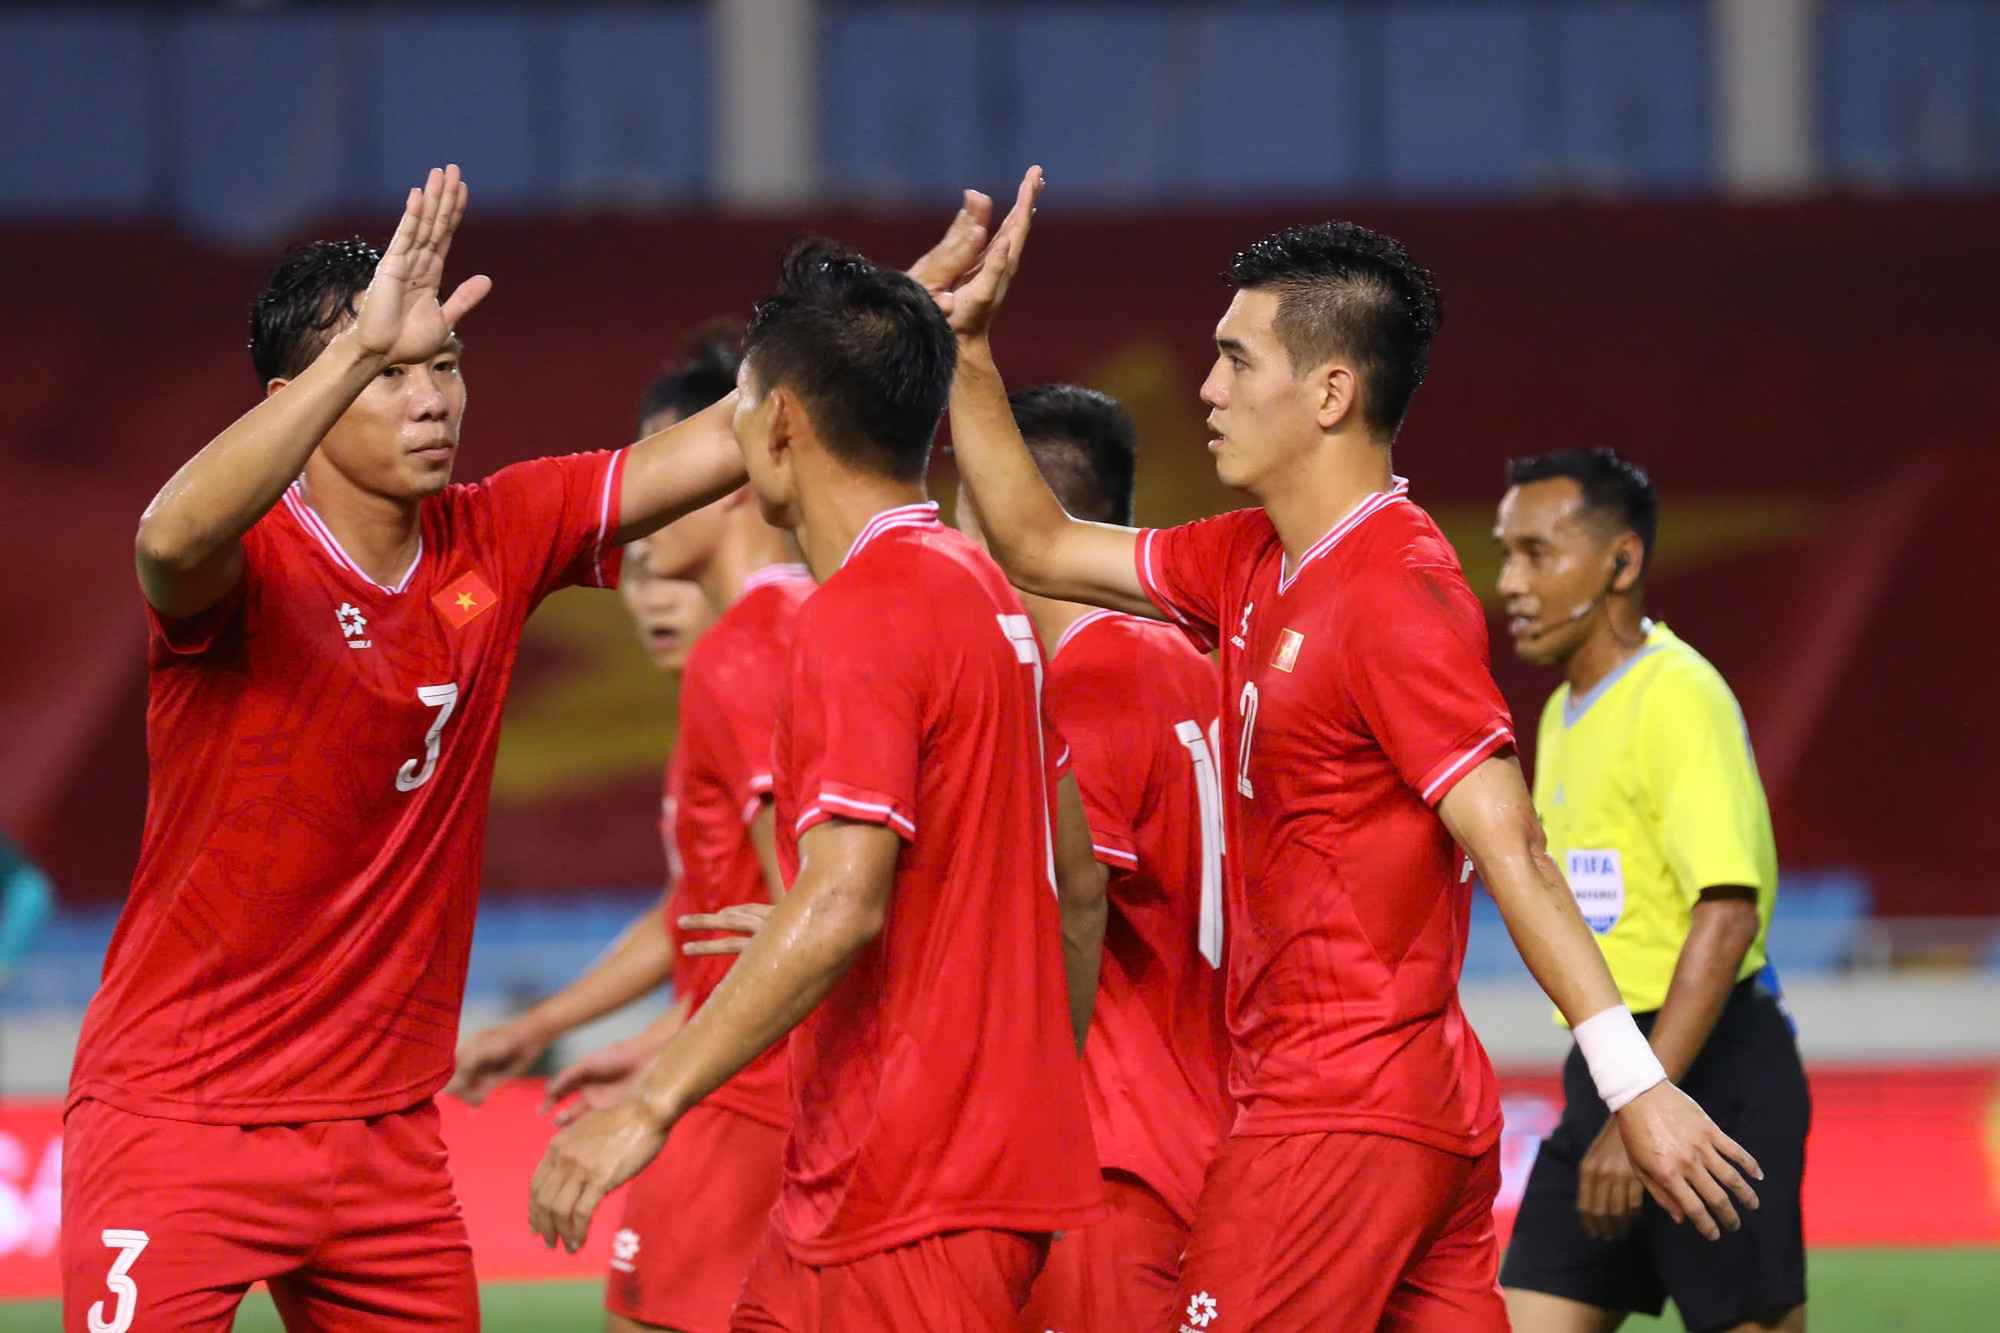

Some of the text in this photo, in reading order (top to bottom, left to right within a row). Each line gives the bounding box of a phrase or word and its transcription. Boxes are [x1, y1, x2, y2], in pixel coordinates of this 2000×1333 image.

[395, 682, 459, 792] 3
[1174, 715, 1227, 970] 1
[1571, 856, 1615, 874] FIFA
[87, 1228, 150, 1333] 3
